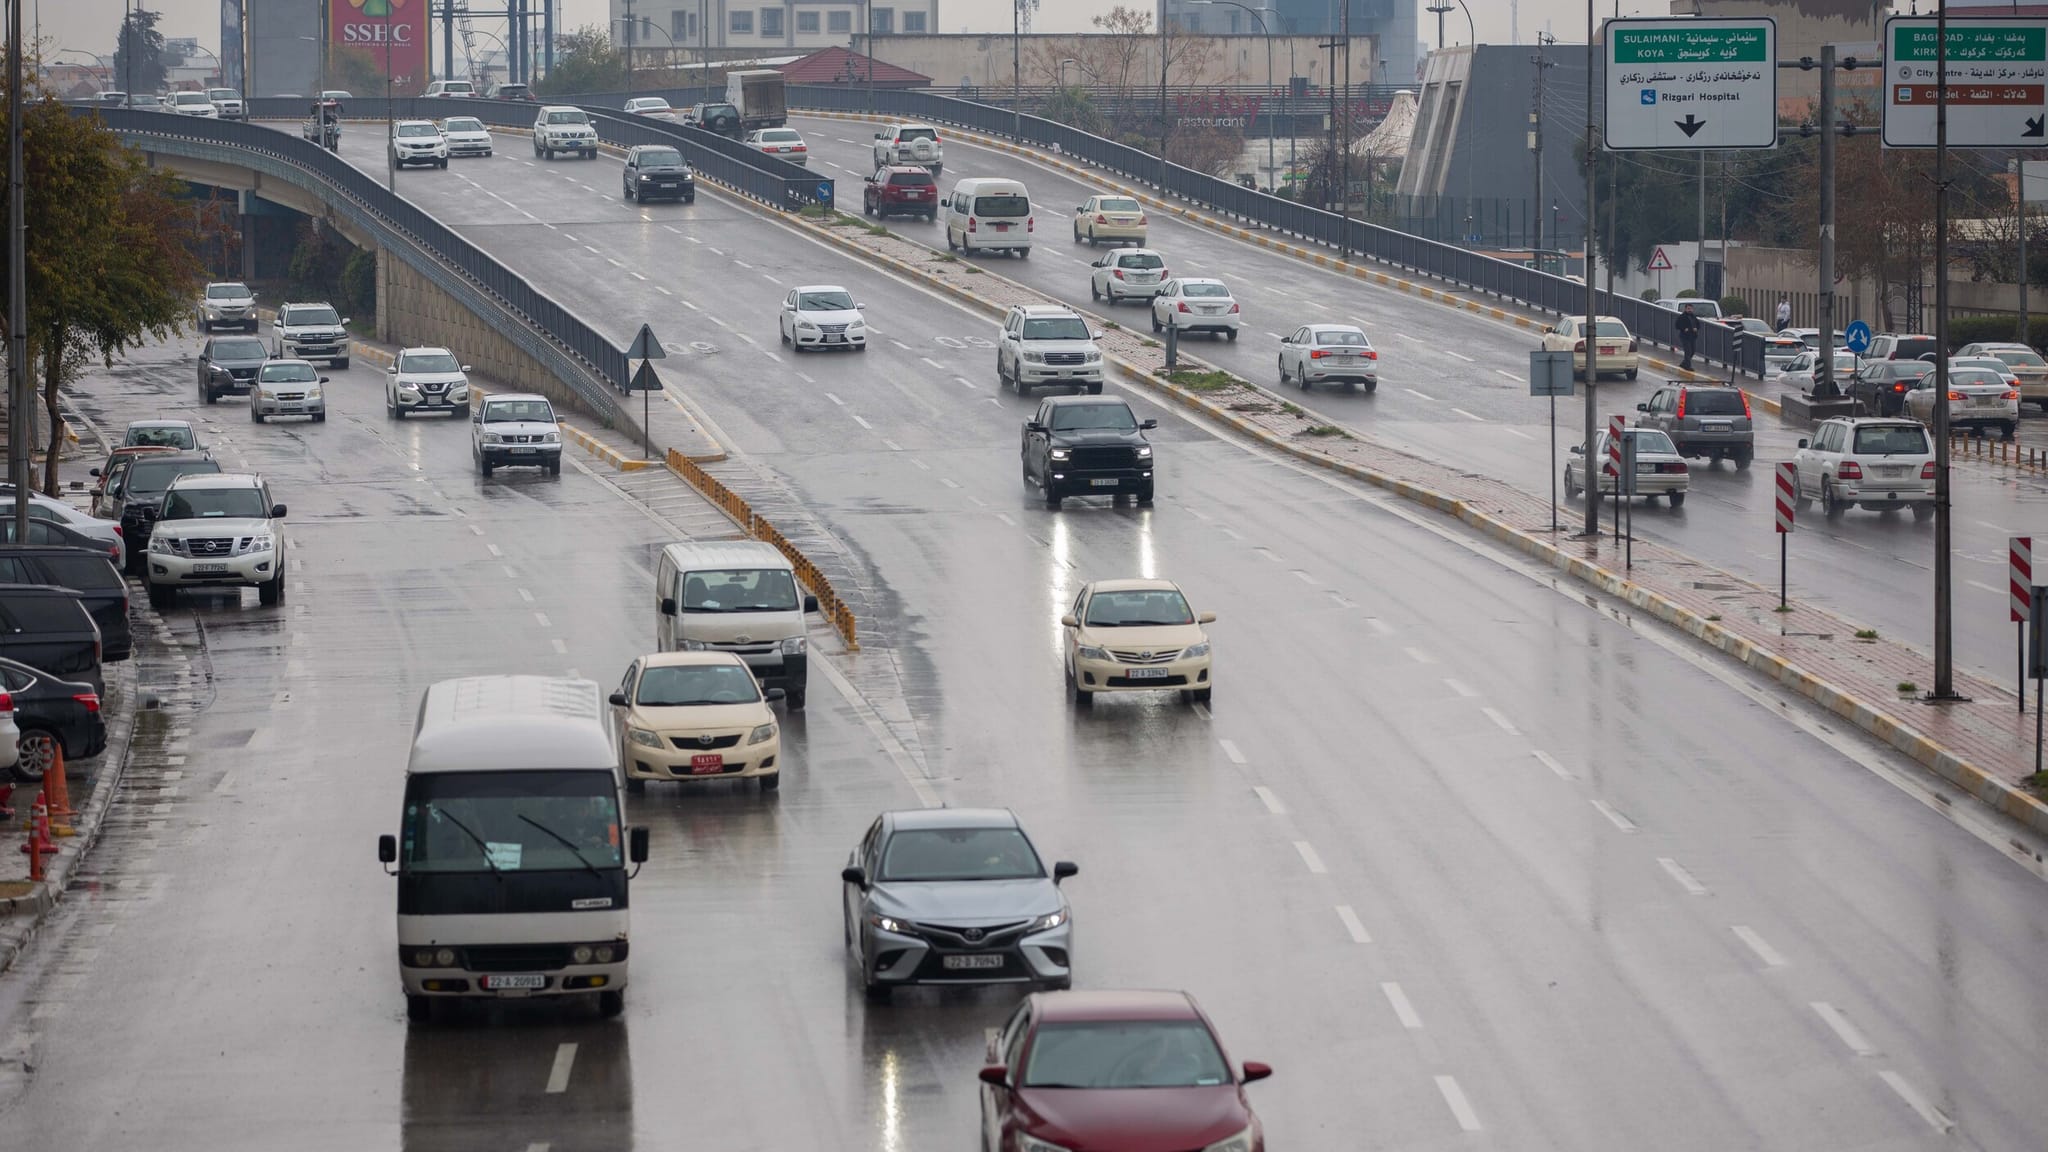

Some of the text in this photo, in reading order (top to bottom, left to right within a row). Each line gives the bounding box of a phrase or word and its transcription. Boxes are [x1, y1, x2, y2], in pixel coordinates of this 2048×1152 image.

[344, 23, 411, 42] SSHC
[1623, 35, 1680, 44] SULAIMANI
[1637, 49, 1665, 58] KOYA
[1913, 48, 1951, 56] KIRKK
[1916, 69, 1934, 78] City
[1662, 92, 1740, 103] Rizgari Hospital
[1925, 90, 1959, 99] Citdel
[1177, 117, 1245, 127] restaurant
